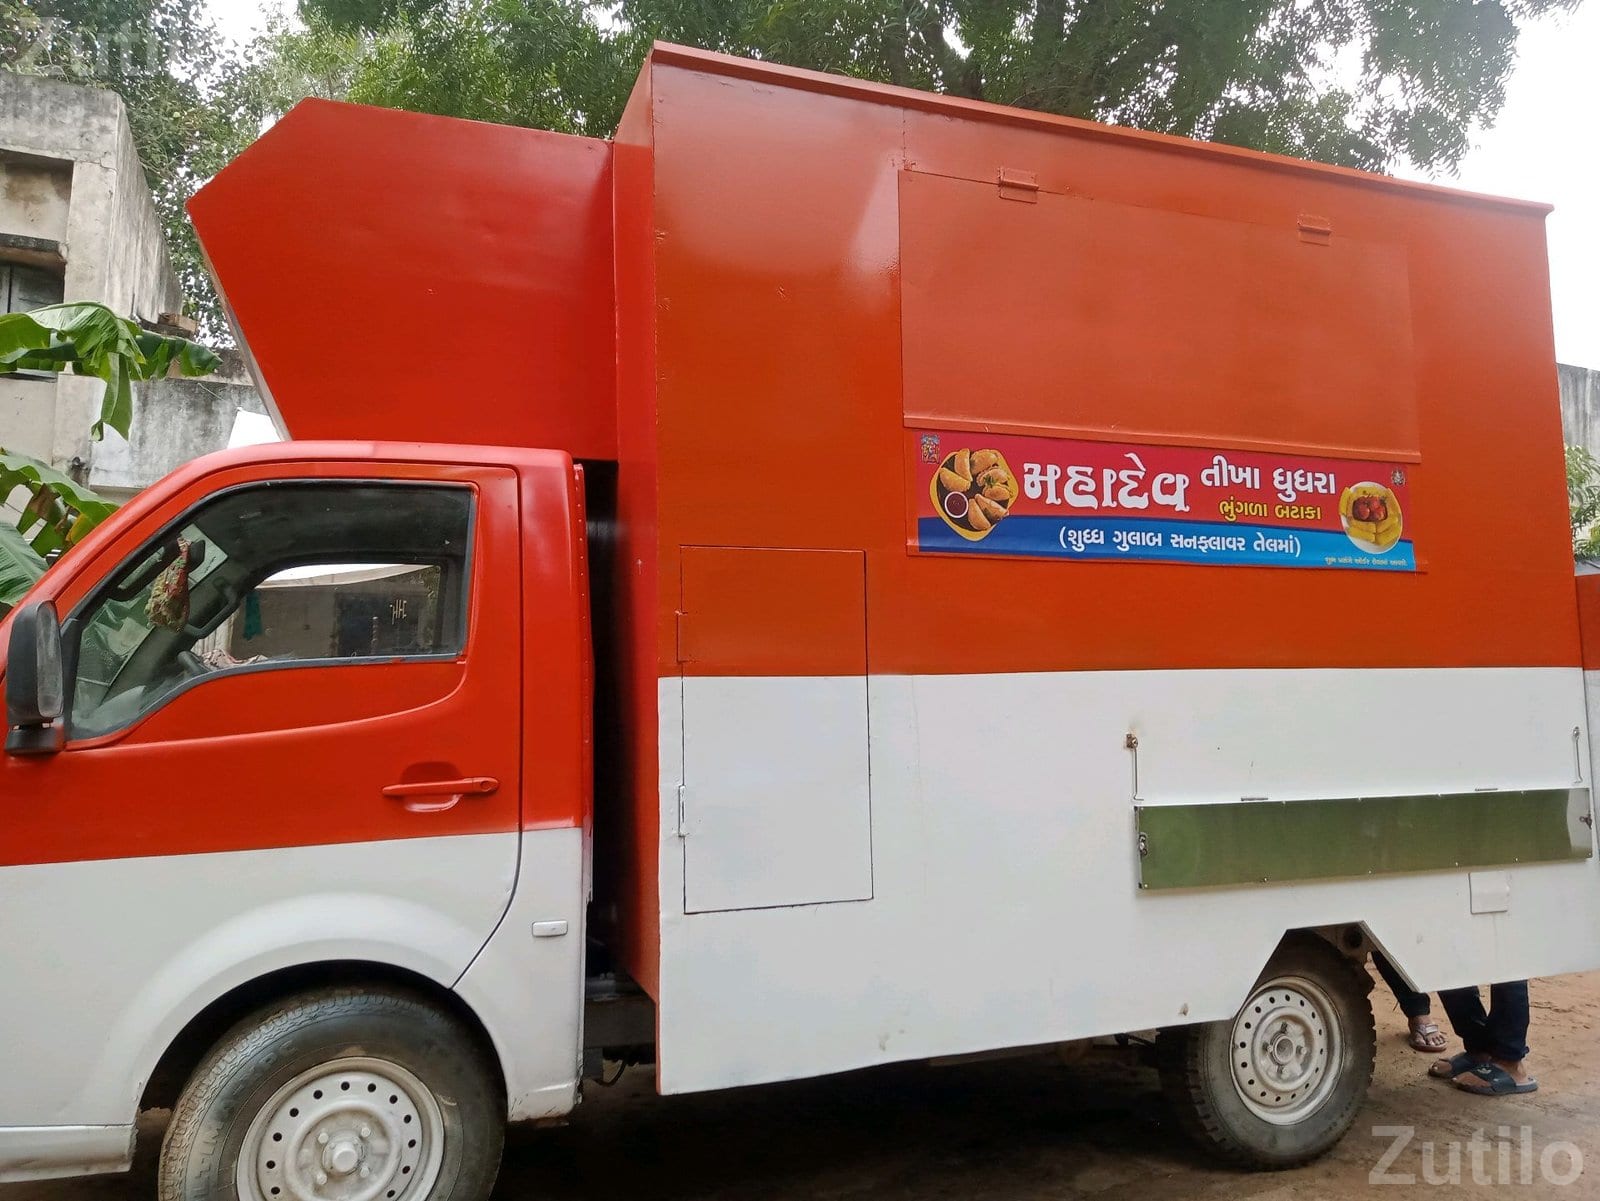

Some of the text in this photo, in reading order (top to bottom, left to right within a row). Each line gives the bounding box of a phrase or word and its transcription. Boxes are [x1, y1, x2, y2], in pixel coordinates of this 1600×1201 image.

[1023, 452, 1190, 512] મહાદેવ
[1200, 454, 1260, 489] તીખા
[1219, 496, 1322, 522] ભુંગળા બટાકા
[1112, 530, 1163, 552] ગુલાબ
[1253, 532, 1301, 557] તેલમાં)
